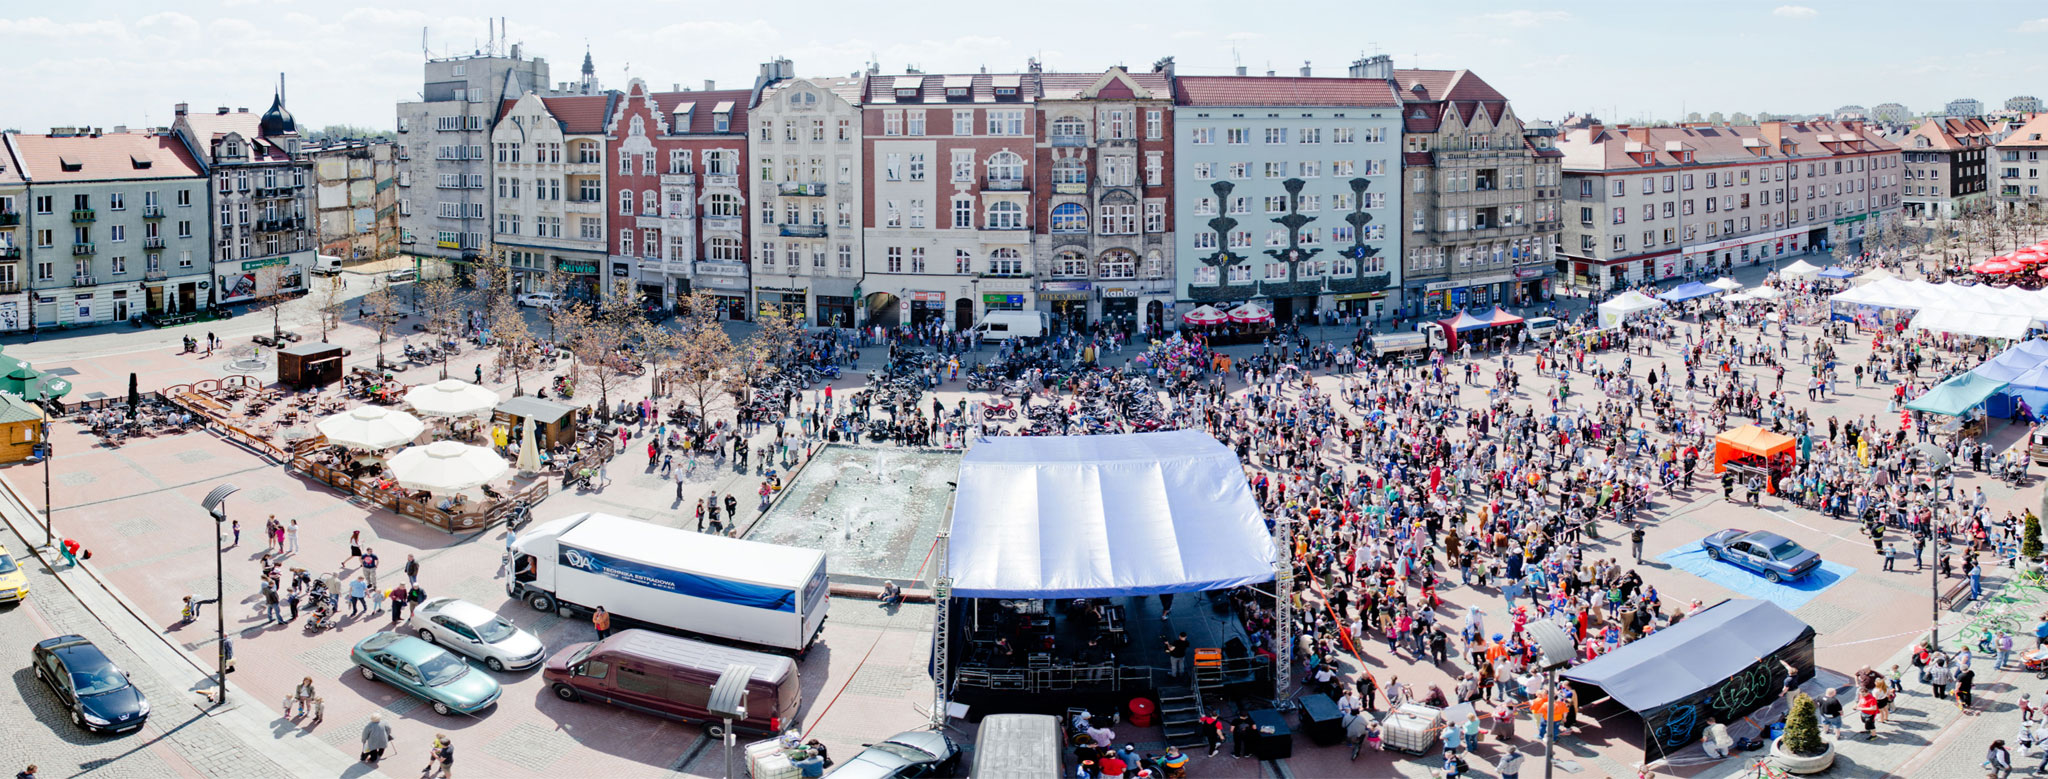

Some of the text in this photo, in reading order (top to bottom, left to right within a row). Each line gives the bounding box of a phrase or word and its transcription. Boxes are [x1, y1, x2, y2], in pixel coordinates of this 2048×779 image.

[559, 261, 596, 273] obuwie
[1040, 293, 1088, 301] PIEKARNIA
[1102, 287, 1138, 298] kantor
[603, 566, 634, 578] TECHNIKA
[635, 574, 676, 587] ESTRADOWA
